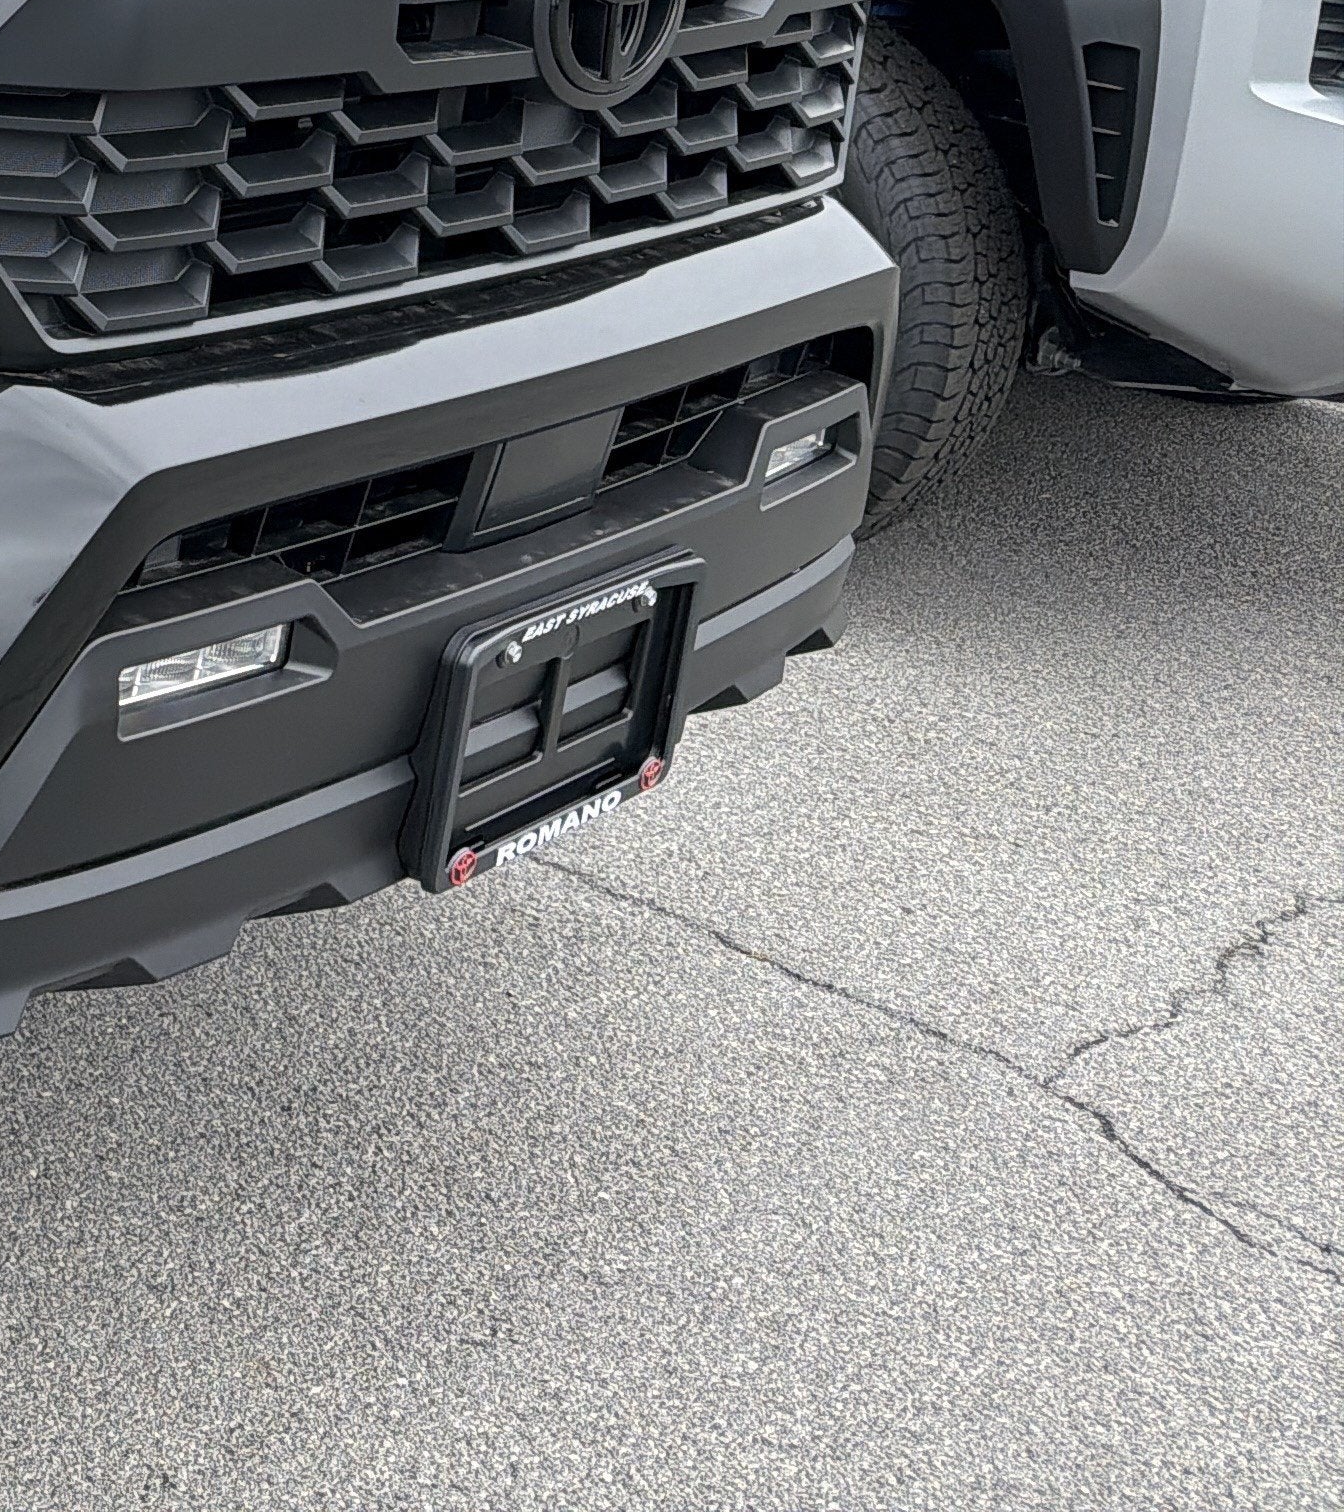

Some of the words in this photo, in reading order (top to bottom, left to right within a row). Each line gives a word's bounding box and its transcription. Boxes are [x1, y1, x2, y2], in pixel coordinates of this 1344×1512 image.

[521, 613, 567, 643] EAST
[566, 581, 650, 625] SYRACUSE
[496, 790, 622, 868] ROMANO
